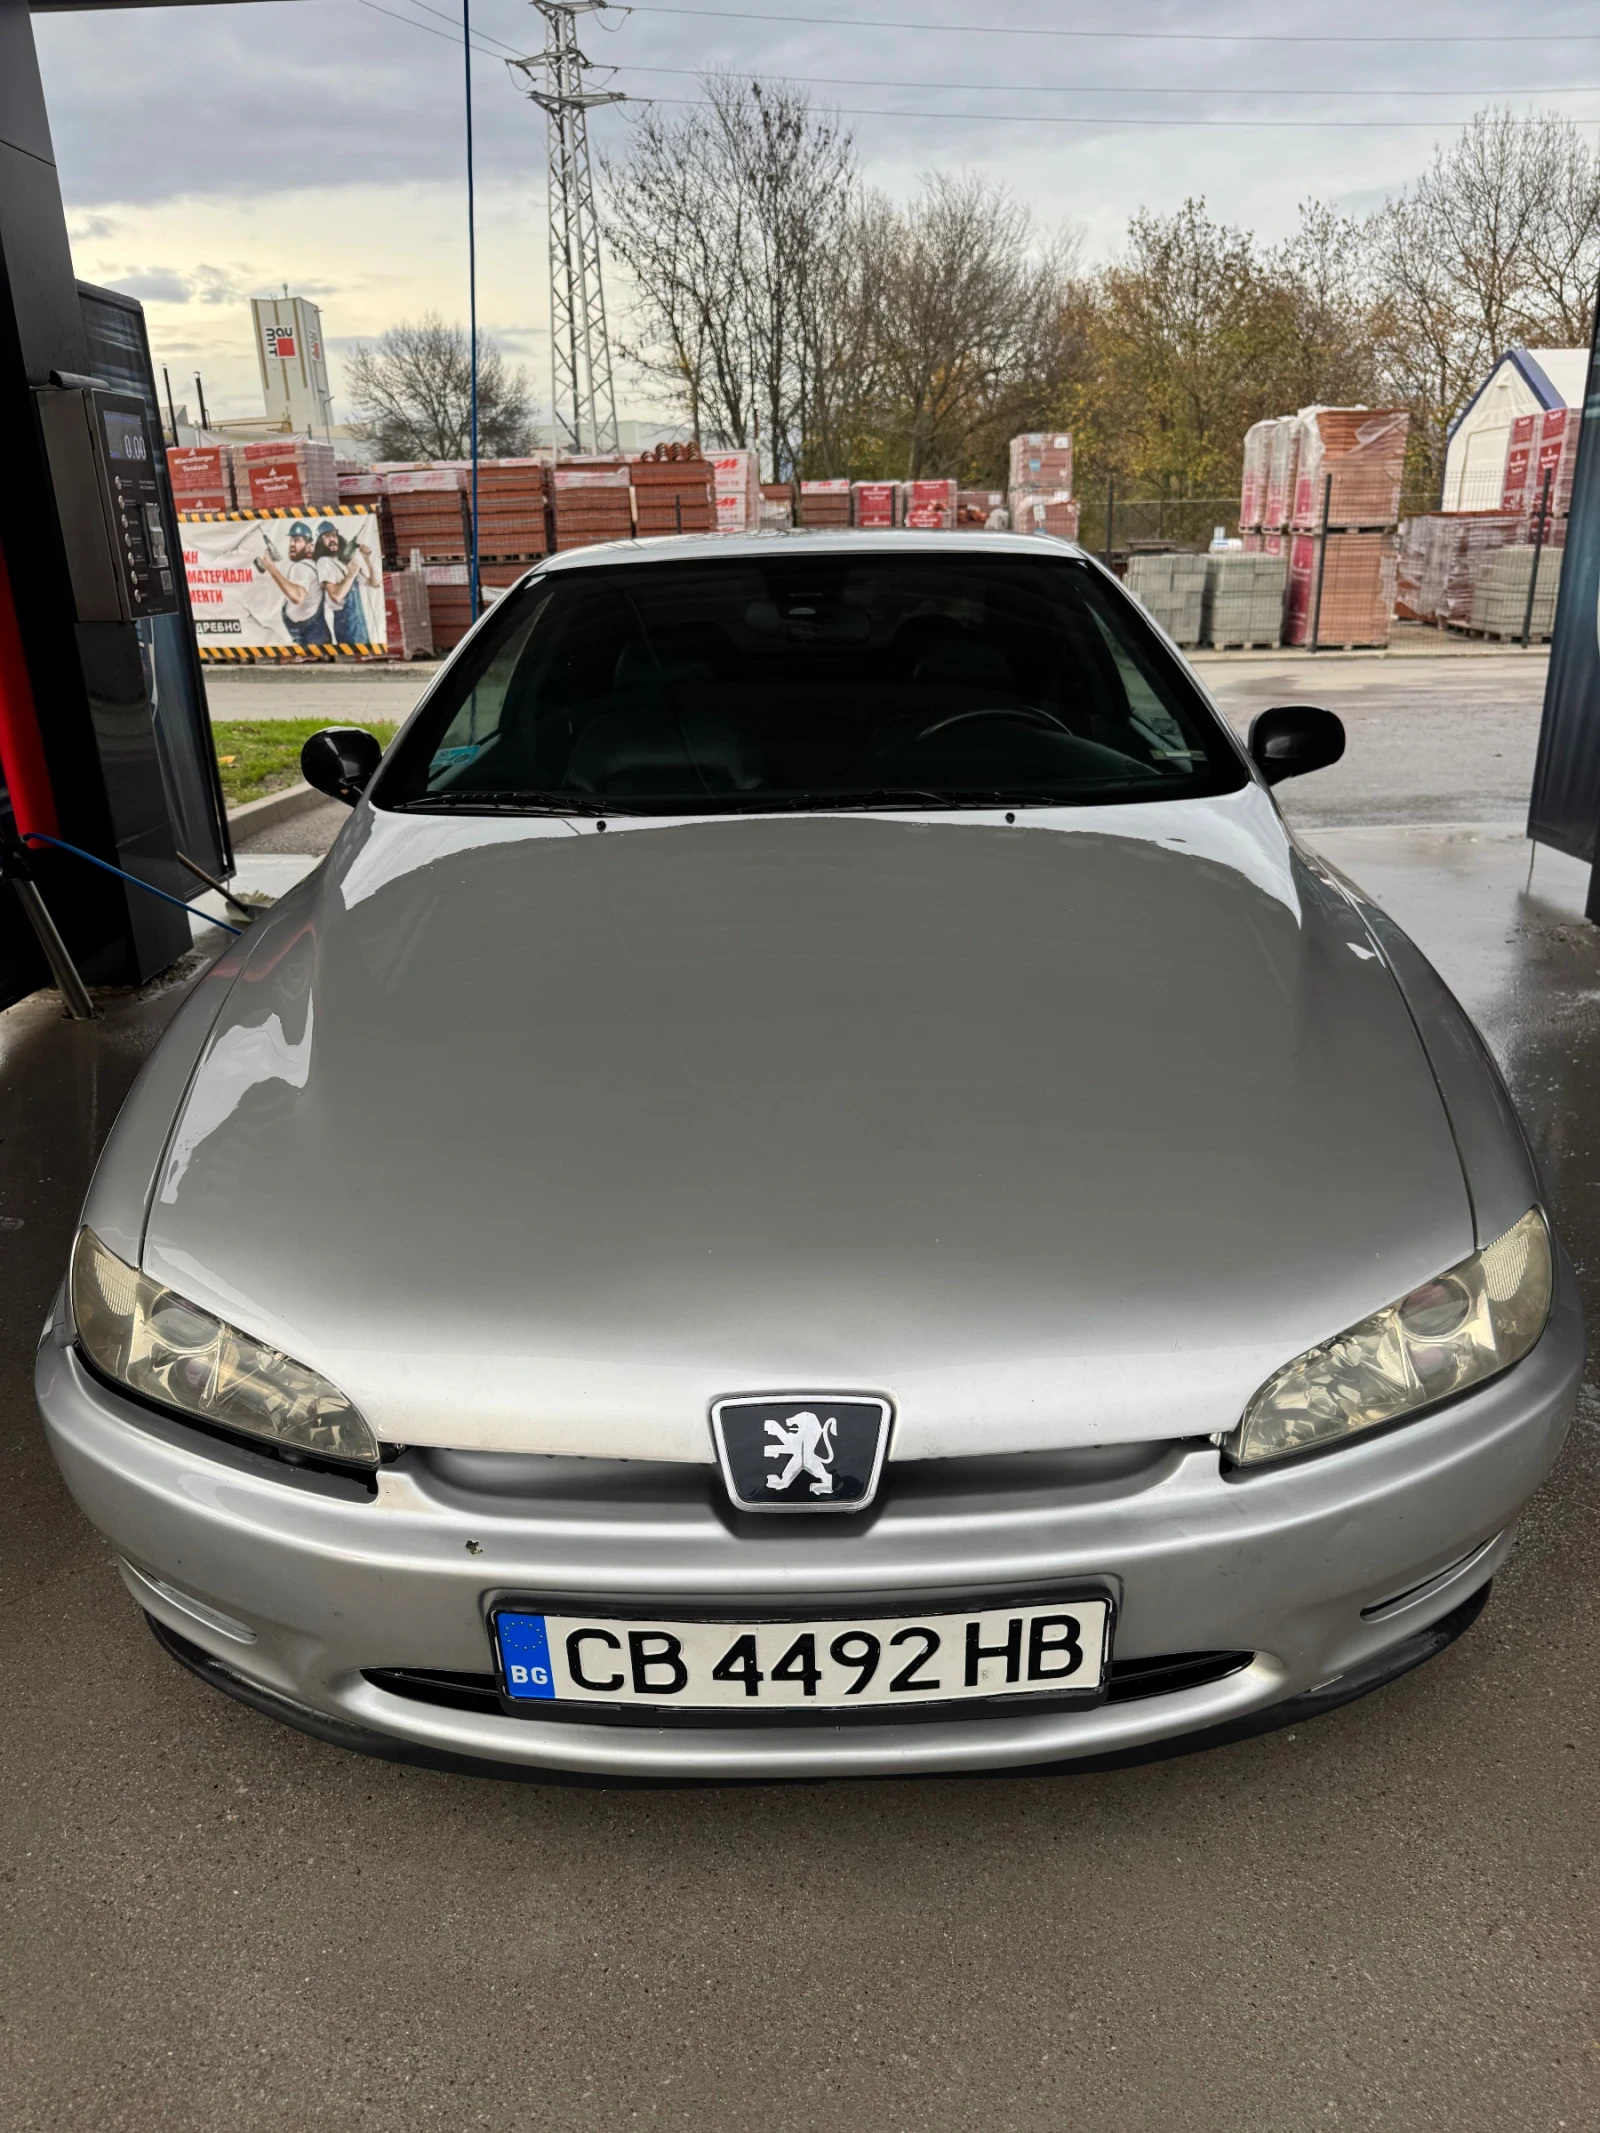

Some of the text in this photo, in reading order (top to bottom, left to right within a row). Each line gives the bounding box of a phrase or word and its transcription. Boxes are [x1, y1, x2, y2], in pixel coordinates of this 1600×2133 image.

[124, 435, 147, 459] 0.00
[187, 569, 253, 584] МАТЕРИАЛИ
[566, 1614, 1084, 1697] CB 4492 HB
[511, 1665, 548, 1685] BG
